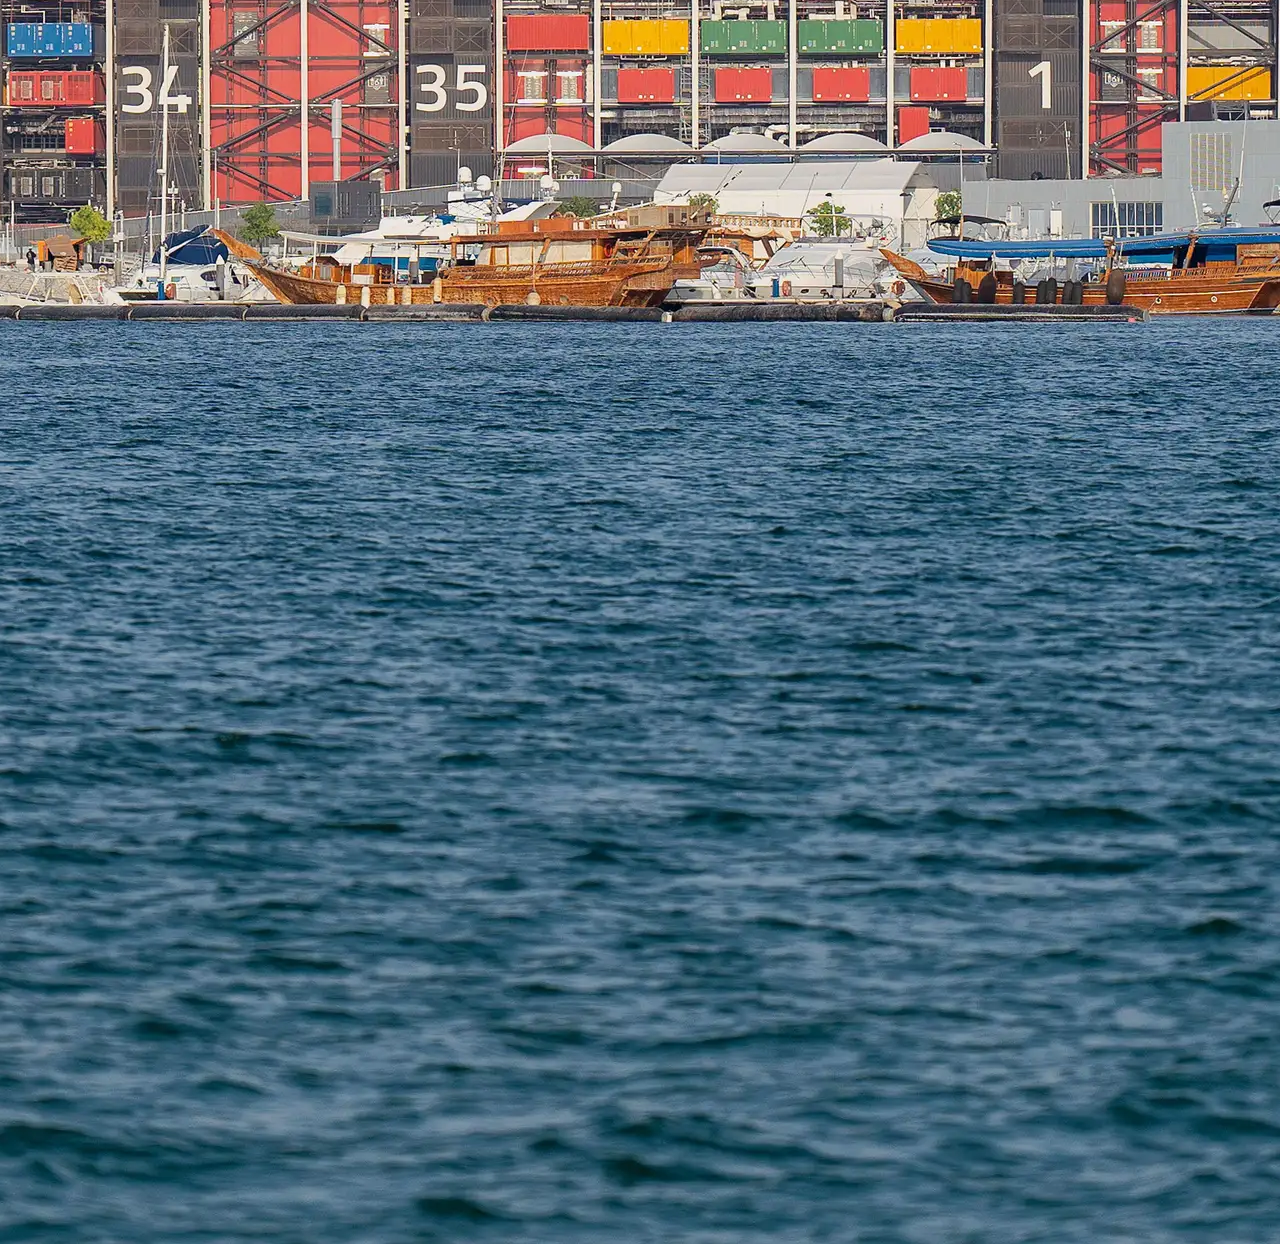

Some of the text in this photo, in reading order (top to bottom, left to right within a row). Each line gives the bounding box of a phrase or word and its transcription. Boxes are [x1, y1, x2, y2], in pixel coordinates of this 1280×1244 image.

[122, 66, 192, 114] 34
[416, 65, 488, 112] 35
[1028, 61, 1051, 109] 1
